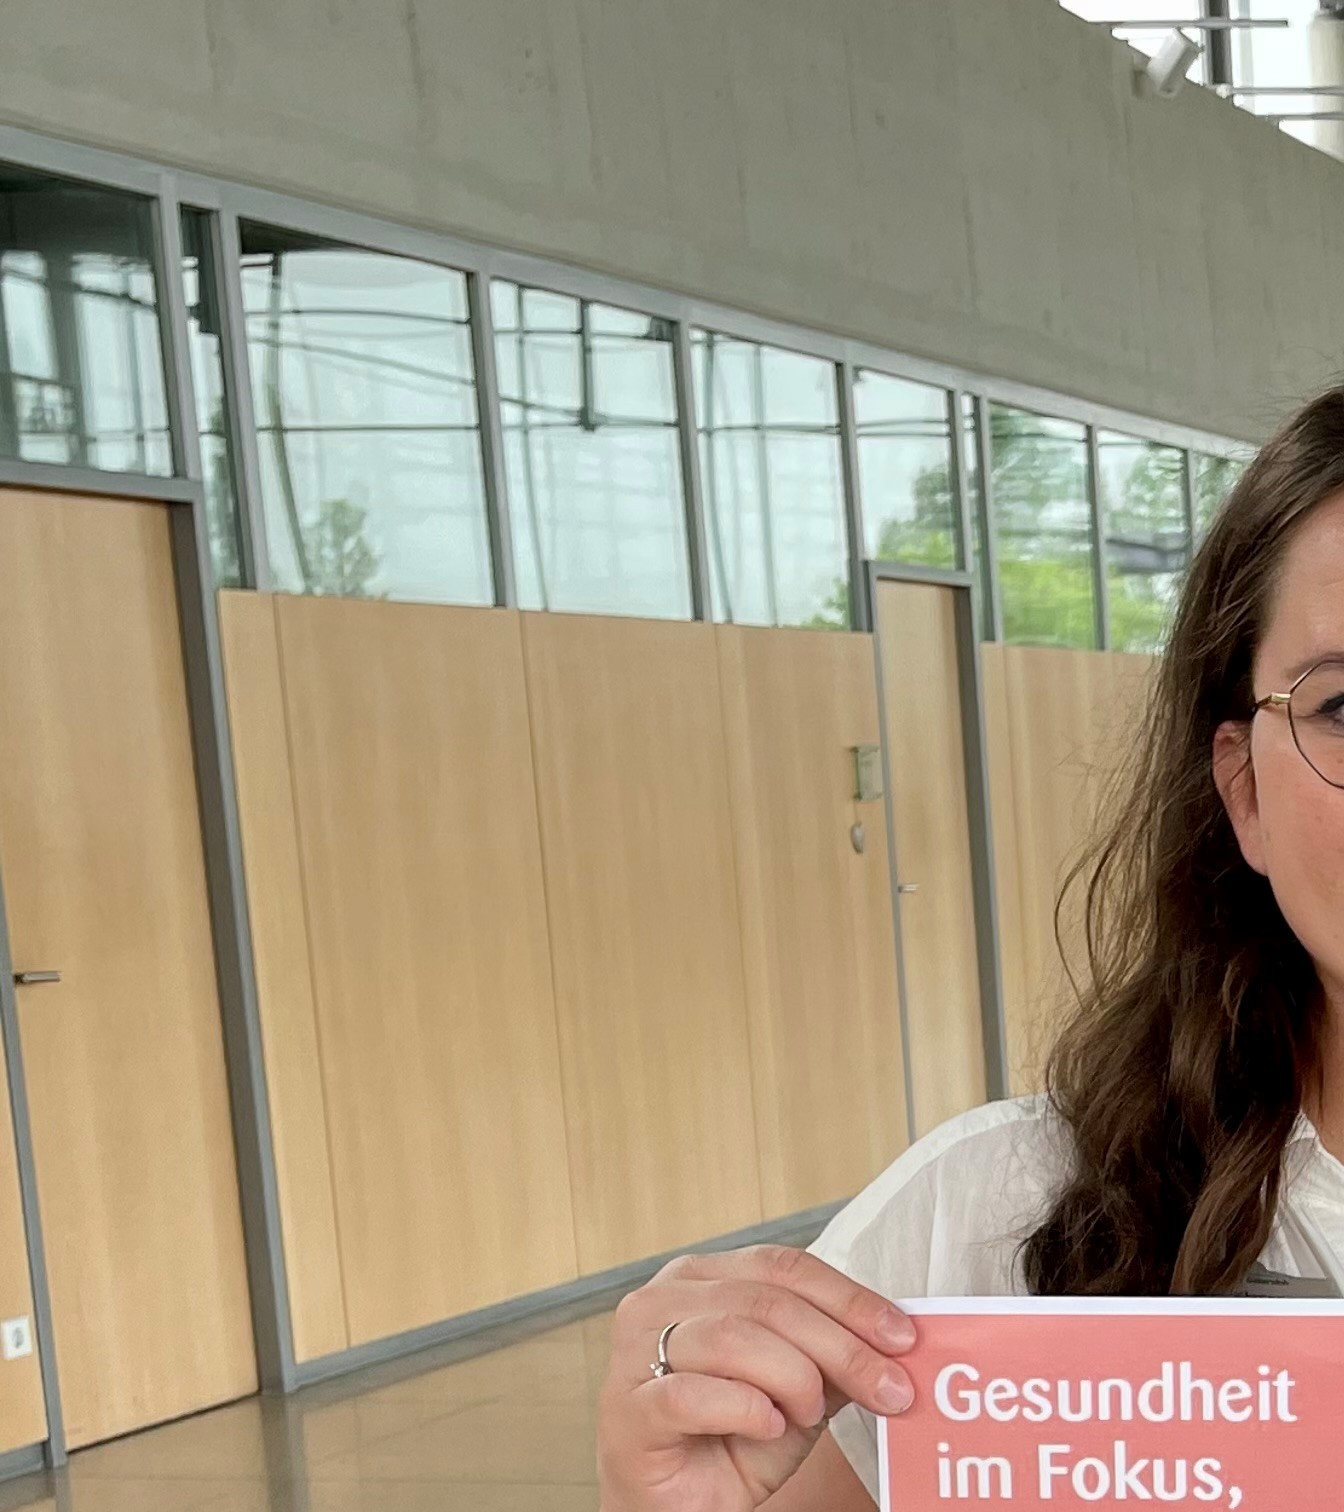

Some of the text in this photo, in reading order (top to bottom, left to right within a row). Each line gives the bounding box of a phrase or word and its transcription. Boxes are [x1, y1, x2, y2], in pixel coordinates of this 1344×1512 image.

[934, 1361, 1298, 1422] Gesundheit
[937, 1440, 1243, 1510] im Fokus,
